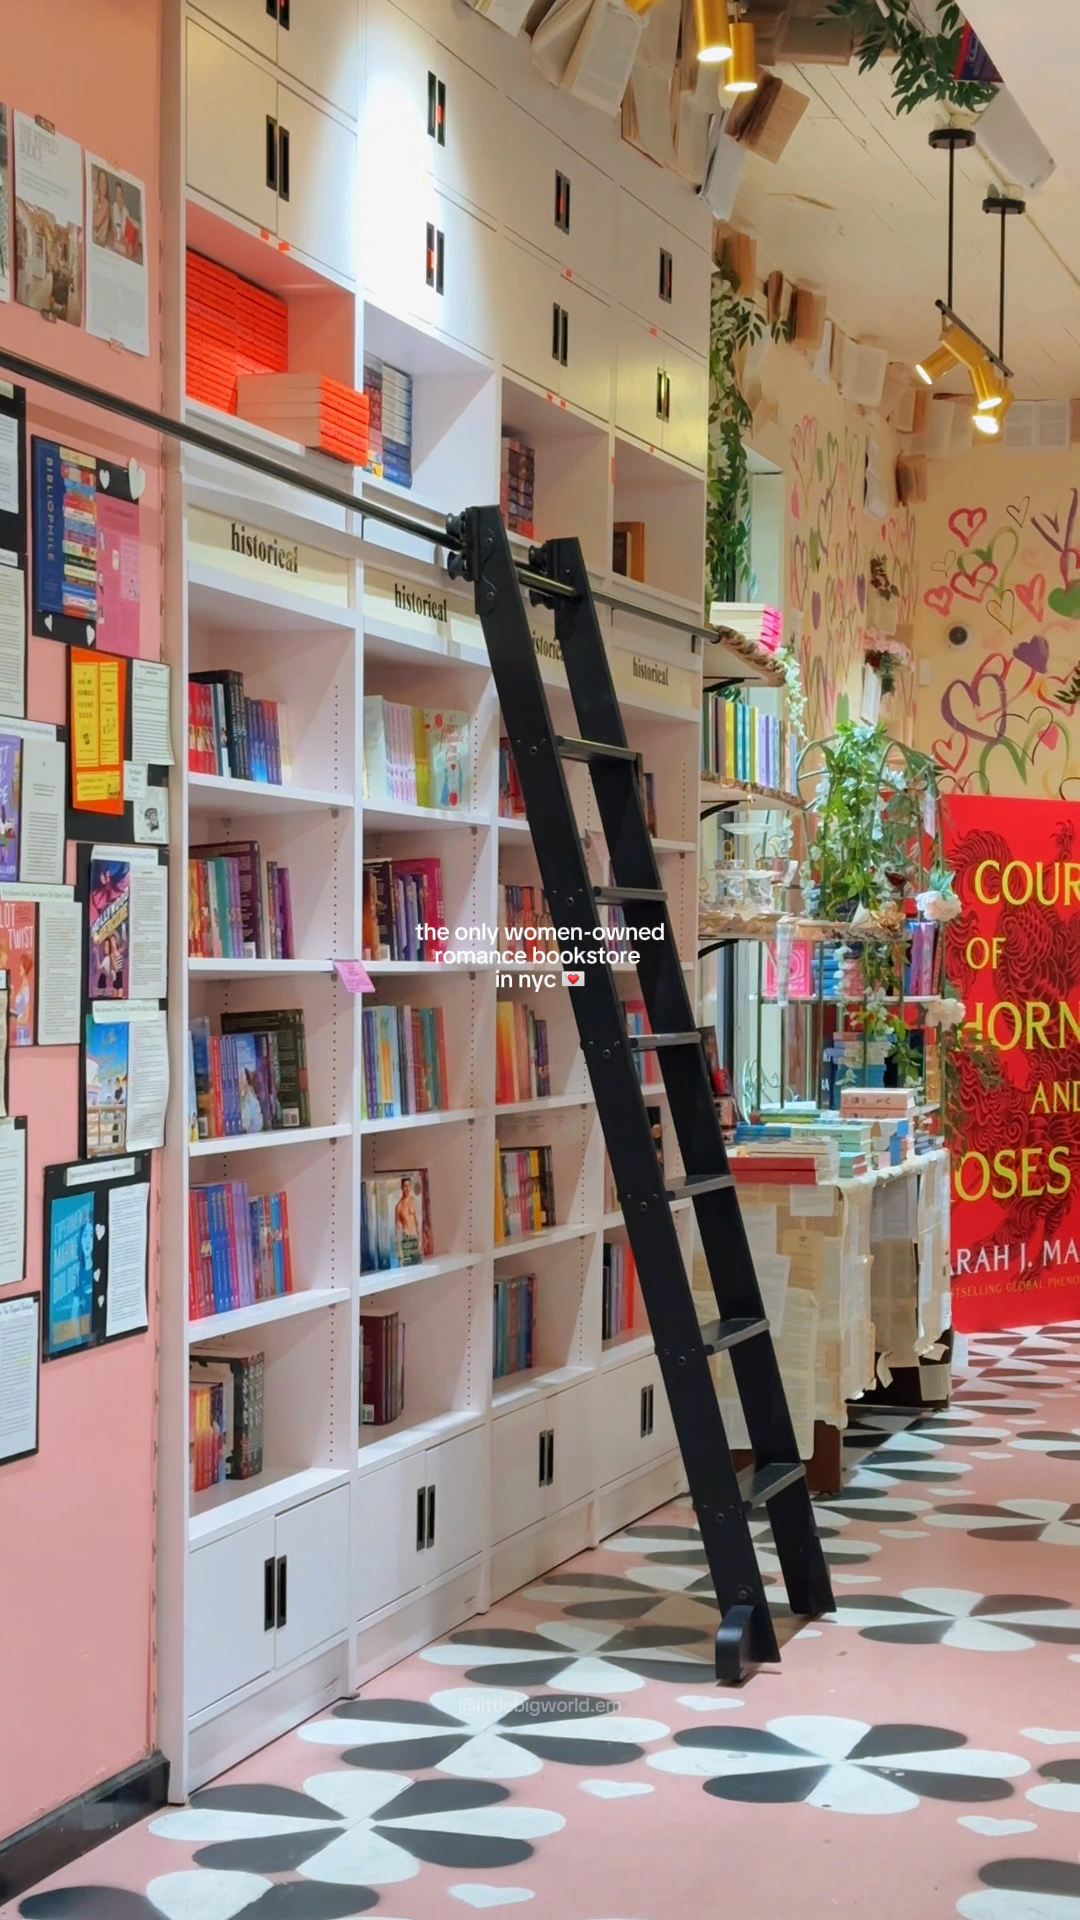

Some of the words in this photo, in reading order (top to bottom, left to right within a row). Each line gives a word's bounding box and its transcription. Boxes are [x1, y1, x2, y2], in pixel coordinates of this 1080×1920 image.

[46, 457, 55, 562] BIBLIOPHILE
[231, 522, 299, 574] historical
[394, 582, 448, 623] historical
[531, 631, 564, 661] istoric
[632, 656, 669, 686] historical
[974, 859, 1080, 906] COUR
[0, 902, 16, 929] LOT
[8, 925, 35, 951] TWIST
[966, 936, 1006, 970] OF
[956, 1001, 1080, 1051] HORN
[954, 1145, 1071, 1202] OSES
[950, 1245, 1010, 1276] RAH
[1019, 1242, 1034, 1275] J.
[1043, 1237, 1080, 1267] MA
[951, 1283, 1003, 1299] TSELLING
[1006, 1280, 1044, 1294] GLOBAL
[1048, 1274, 1080, 1288] PHENO
